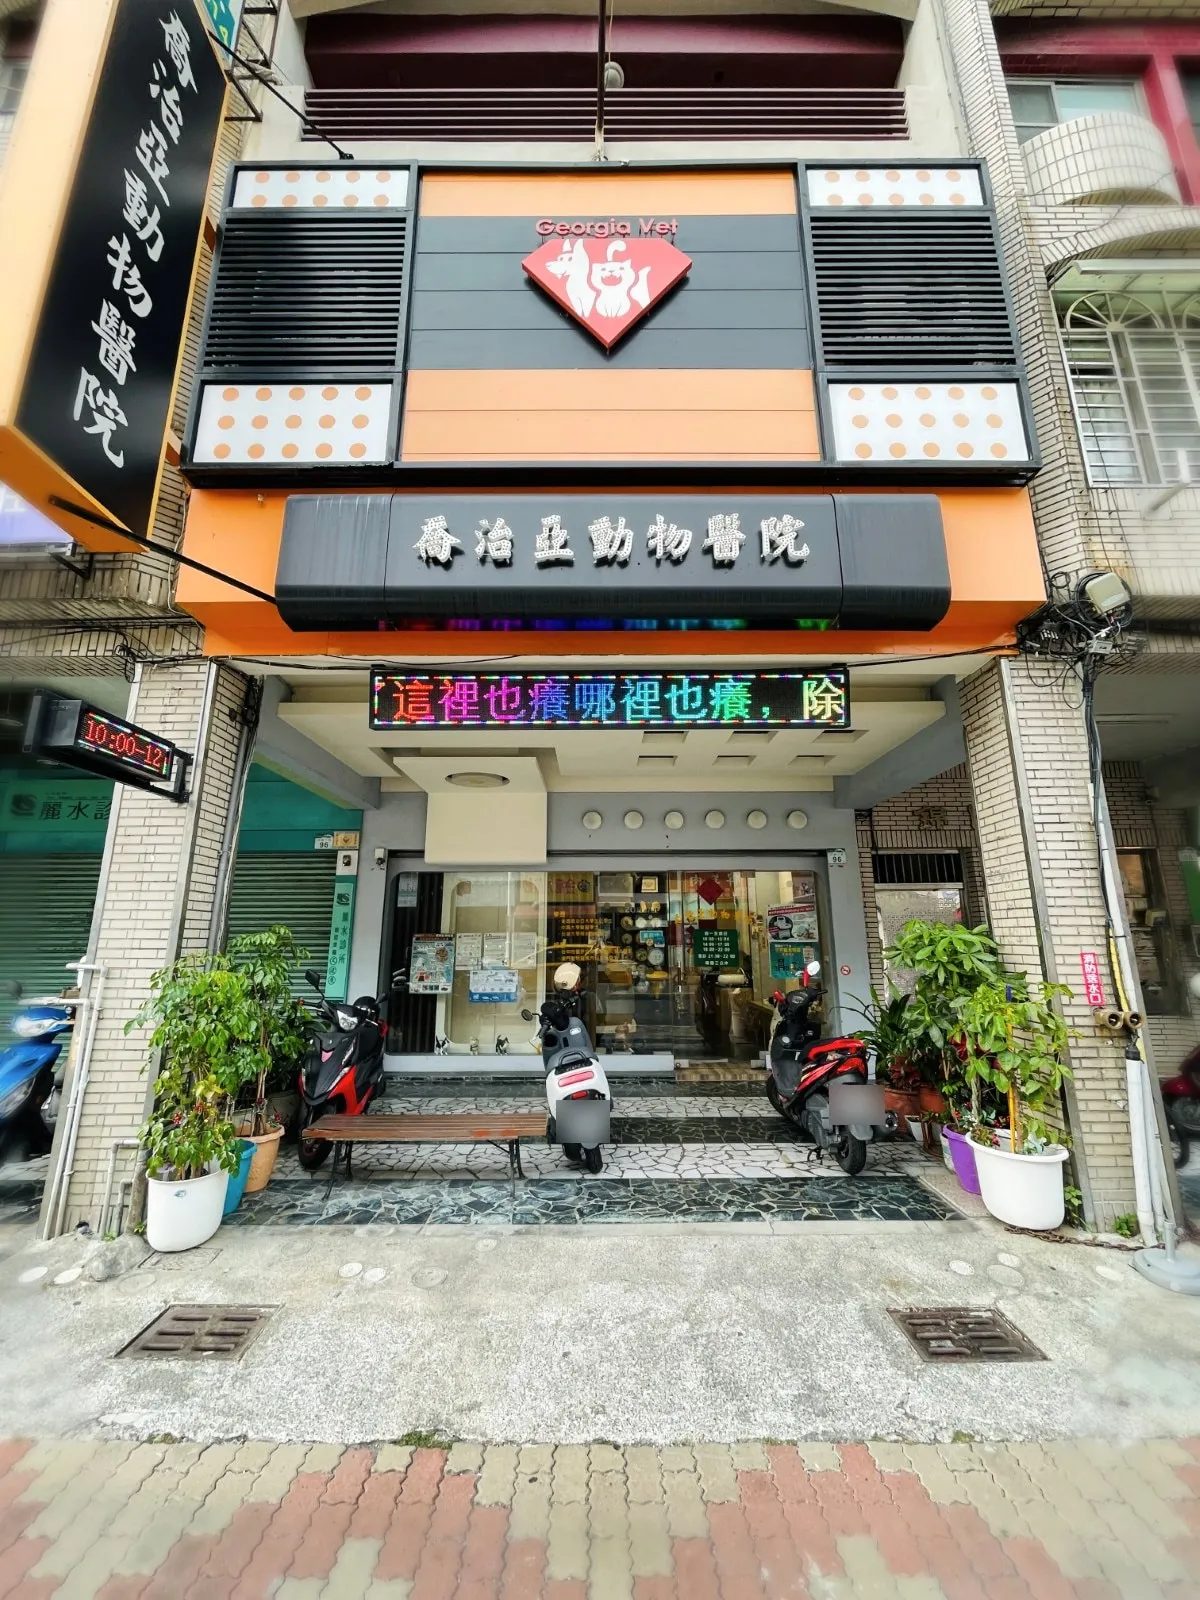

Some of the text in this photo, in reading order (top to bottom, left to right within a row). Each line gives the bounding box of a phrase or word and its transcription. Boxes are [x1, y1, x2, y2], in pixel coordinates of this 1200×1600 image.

[73, 8, 198, 469] 喬治亞動物醫院
[535, 217, 679, 239] Georgia Vet
[412, 513, 811, 565] 喬治亞動物醫院
[84, 720, 163, 768] 10:00-12
[1083, 954, 1102, 1004] 消防送水口
